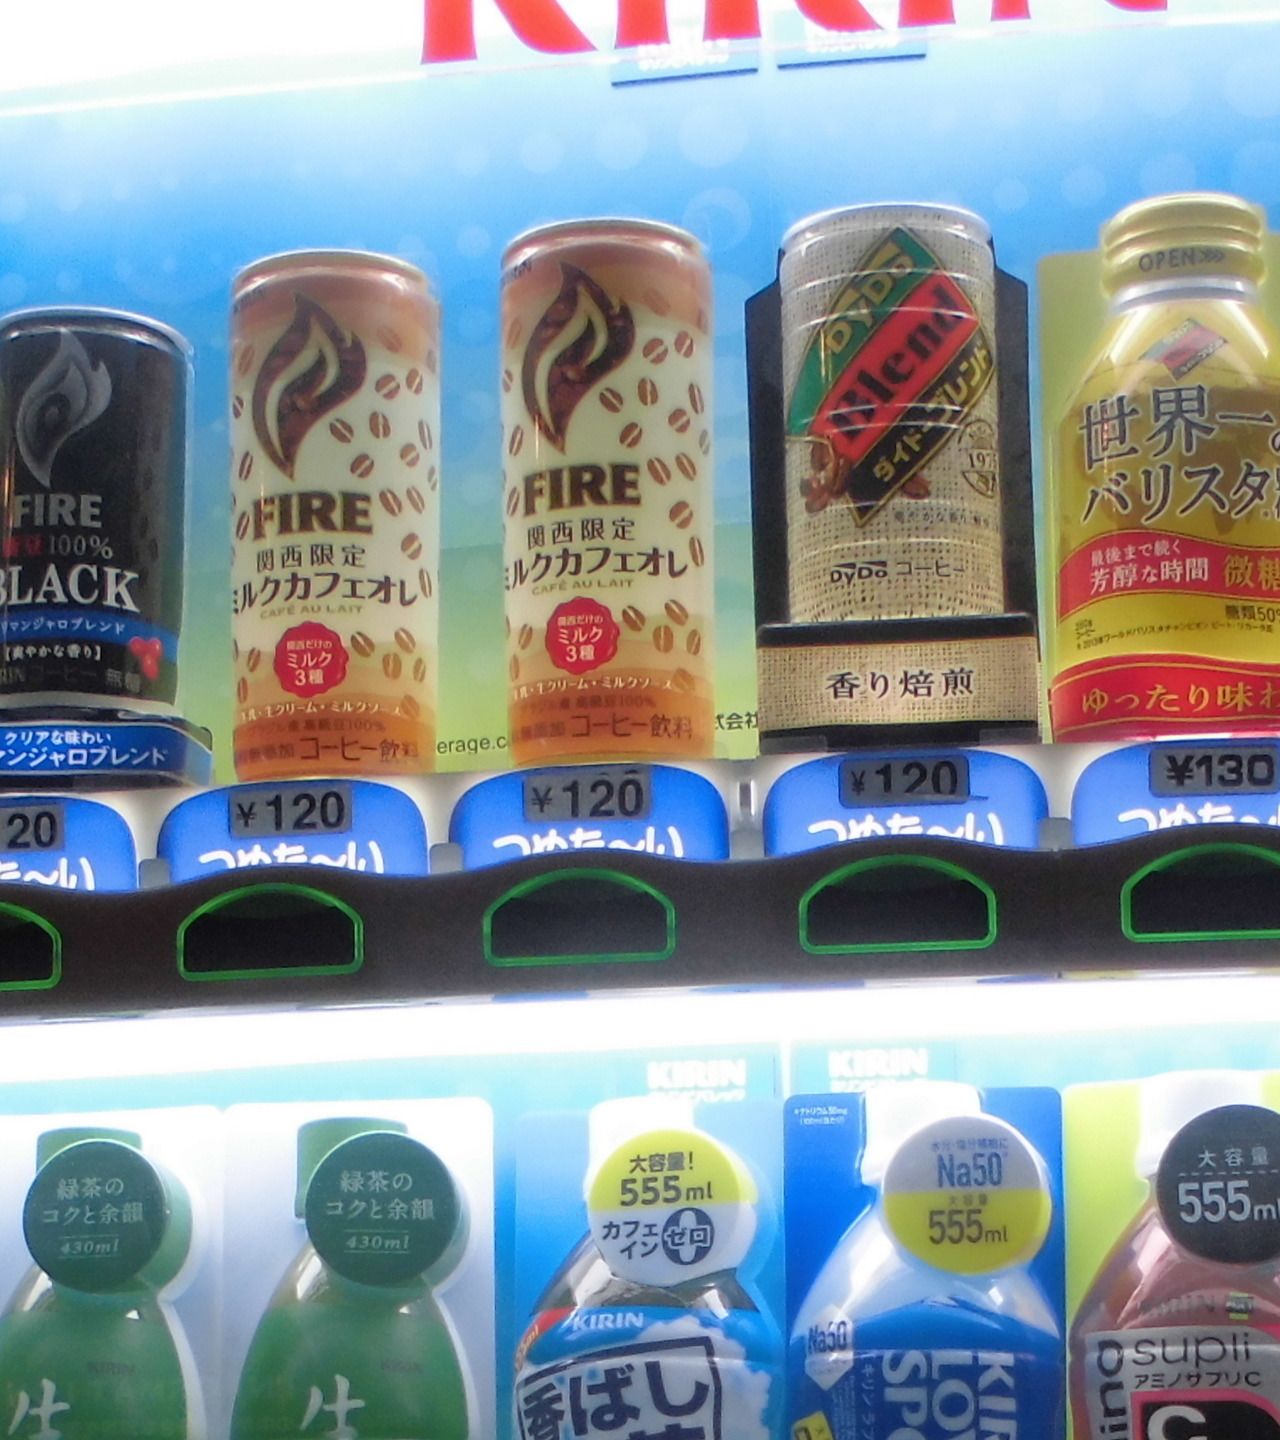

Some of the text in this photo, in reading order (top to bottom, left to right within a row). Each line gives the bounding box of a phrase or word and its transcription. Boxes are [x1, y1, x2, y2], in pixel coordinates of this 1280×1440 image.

[1139, 249, 1196, 271] OPEN
[829, 285, 970, 438] Blend
[524, 464, 642, 515] FIRE
[12, 494, 102, 529] FIRE
[252, 492, 373, 540] FIRE
[527, 518, 637, 548] 関西限定
[256, 544, 366, 572] 関西限定
[1091, 539, 1180, 563] 最後まで続く
[829, 561, 967, 582] DyDo コーヒー
[1090, 556, 1209, 589] 芳醇な時間
[558, 627, 602, 643] ミルク
[287, 652, 332, 668] ミルク
[565, 645, 595, 662] 3種
[294, 668, 325, 686] 3種
[826, 670, 974, 701] 香り焙煎
[5, 731, 111, 745] クリアな味わい
[851, 761, 959, 796] ¥120
[1165, 753, 1274, 788] ¥130
[236, 792, 345, 832] ¥120
[629, 1151, 693, 1173] 大容量!
[1198, 1149, 1269, 1168] 大容量
[57, 1177, 124, 1199] 緑茶の
[340, 1171, 412, 1192] 緑茶の
[620, 1176, 712, 1205] 555ml
[41, 1204, 144, 1227] コクと余韻
[325, 1198, 434, 1221] コクと余韻
[928, 1209, 1008, 1244] 555ml
[60, 1238, 119, 1255] 430ml
[346, 1233, 409, 1250] 430ml
[572, 1313, 645, 1332] KIRIN
[1134, 1334, 1251, 1370] supli
[1134, 1371, 1261, 1388] アミノサプリC
